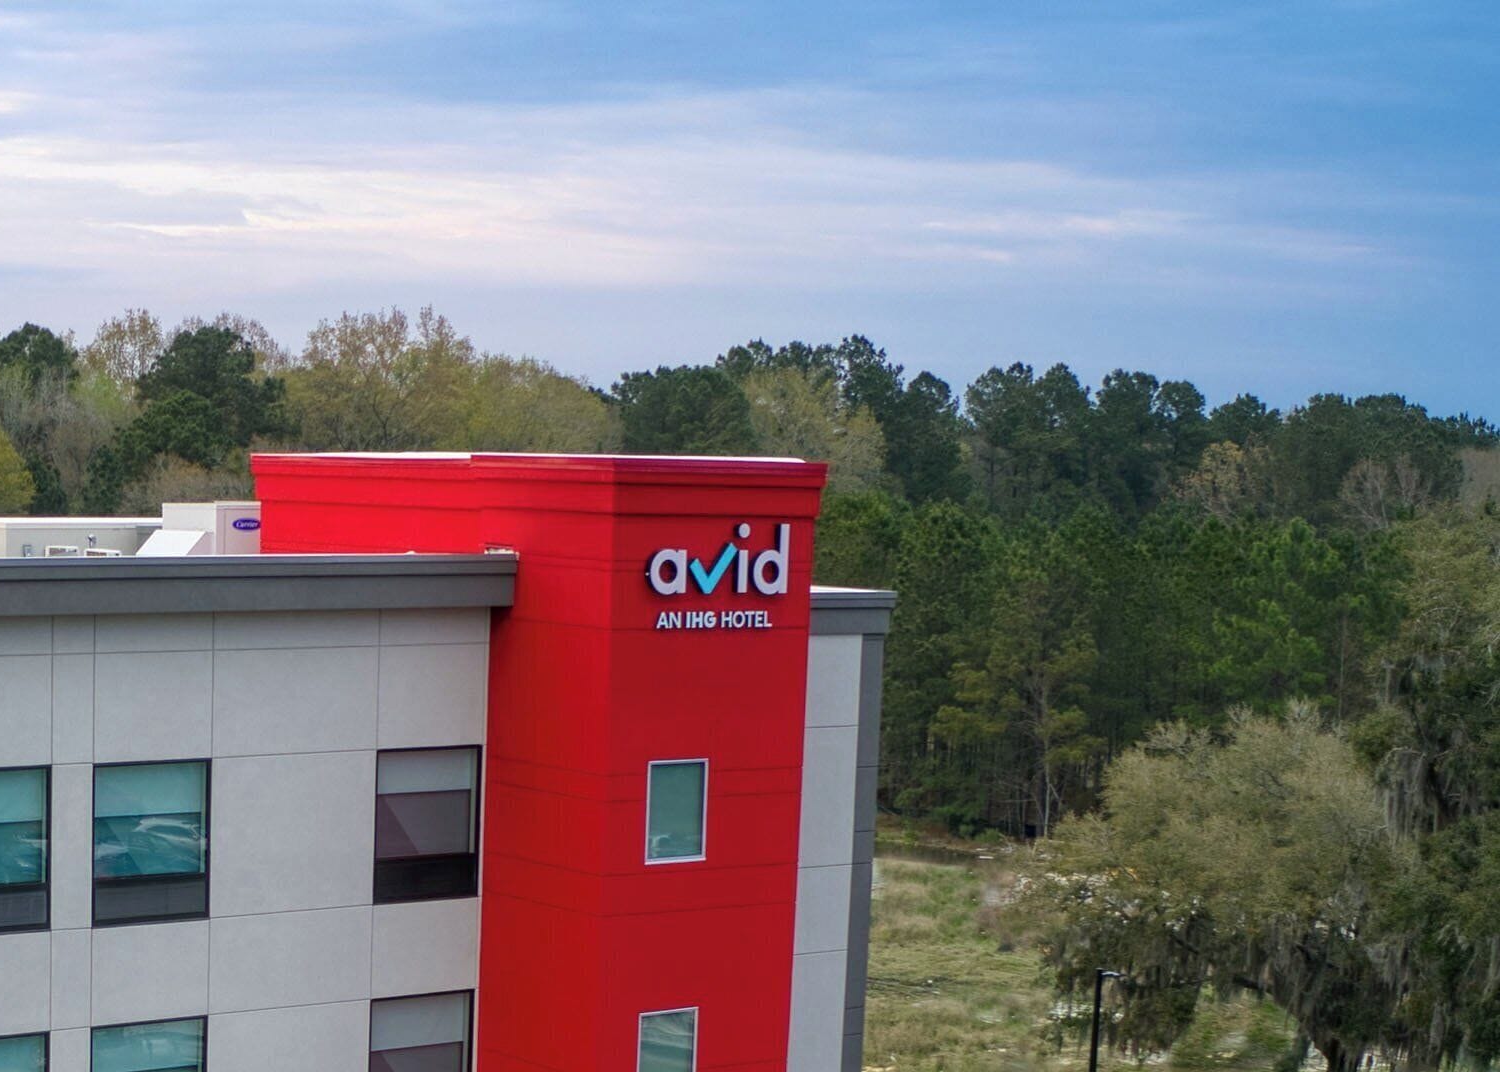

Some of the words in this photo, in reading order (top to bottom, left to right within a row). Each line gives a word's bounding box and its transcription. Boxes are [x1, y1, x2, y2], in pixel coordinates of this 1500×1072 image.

[650, 523, 790, 595] avid
[656, 612, 681, 629] AN
[685, 611, 716, 628] IHG
[721, 611, 772, 627] HOTEL
